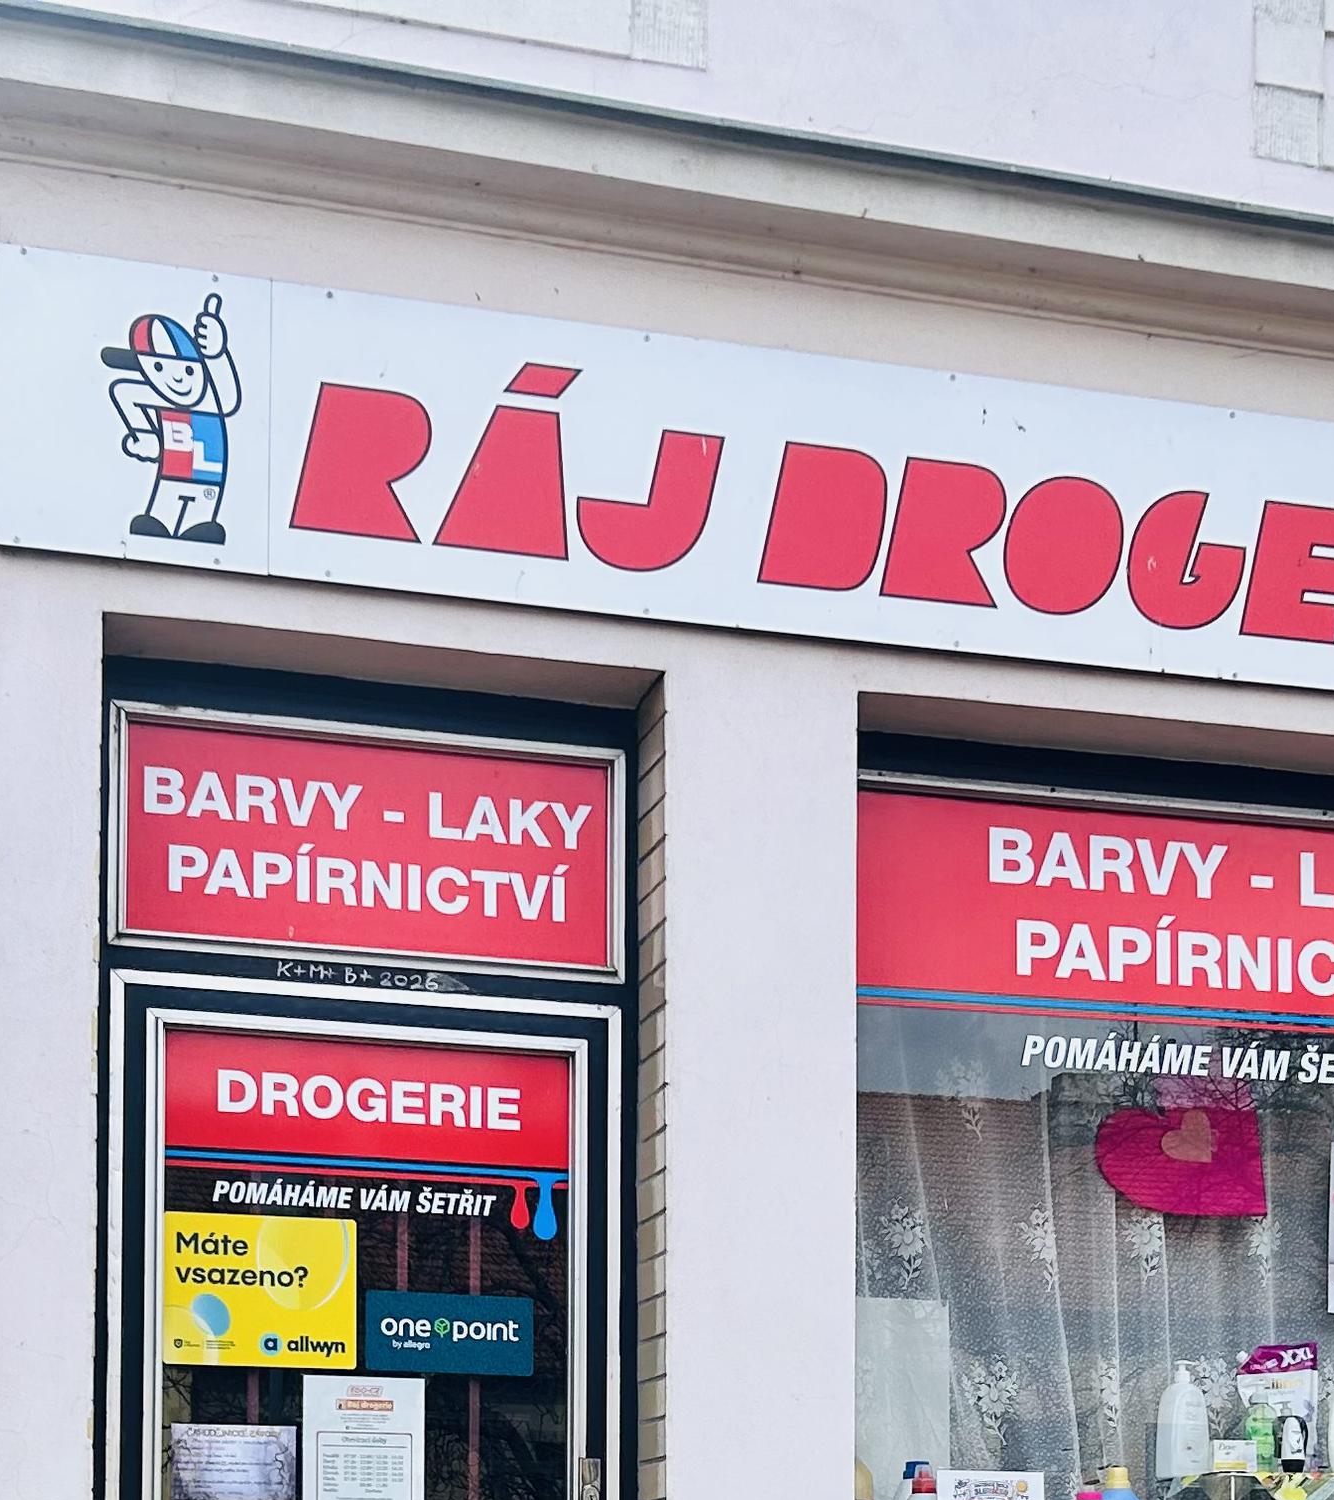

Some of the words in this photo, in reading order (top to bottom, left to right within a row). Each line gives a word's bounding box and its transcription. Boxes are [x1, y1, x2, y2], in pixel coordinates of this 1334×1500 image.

[288, 362, 725, 572] RÁJ
[143, 766, 362, 830] BARVY
[429, 792, 592, 850] LAKY
[988, 826, 1228, 899] BARVY
[168, 844, 569, 923] PAPÍRNICTVÍ
[380, 972, 438, 990] 2026
[1020, 1032, 1211, 1078] POMÁHÁME
[1220, 1041, 1289, 1082] VÁM
[217, 1069, 522, 1131] DROGERIE
[212, 1178, 353, 1209] POMÁHÁME
[357, 1186, 410, 1213] VÁM
[416, 1186, 497, 1217] ŠETŘIT
[176, 1231, 248, 1257] Máte
[175, 1266, 309, 1289] vsazeno?
[287, 1336, 345, 1357] allwyn
[381, 1317, 431, 1338] one
[452, 1320, 520, 1343] point
[392, 1340, 402, 1350] by
